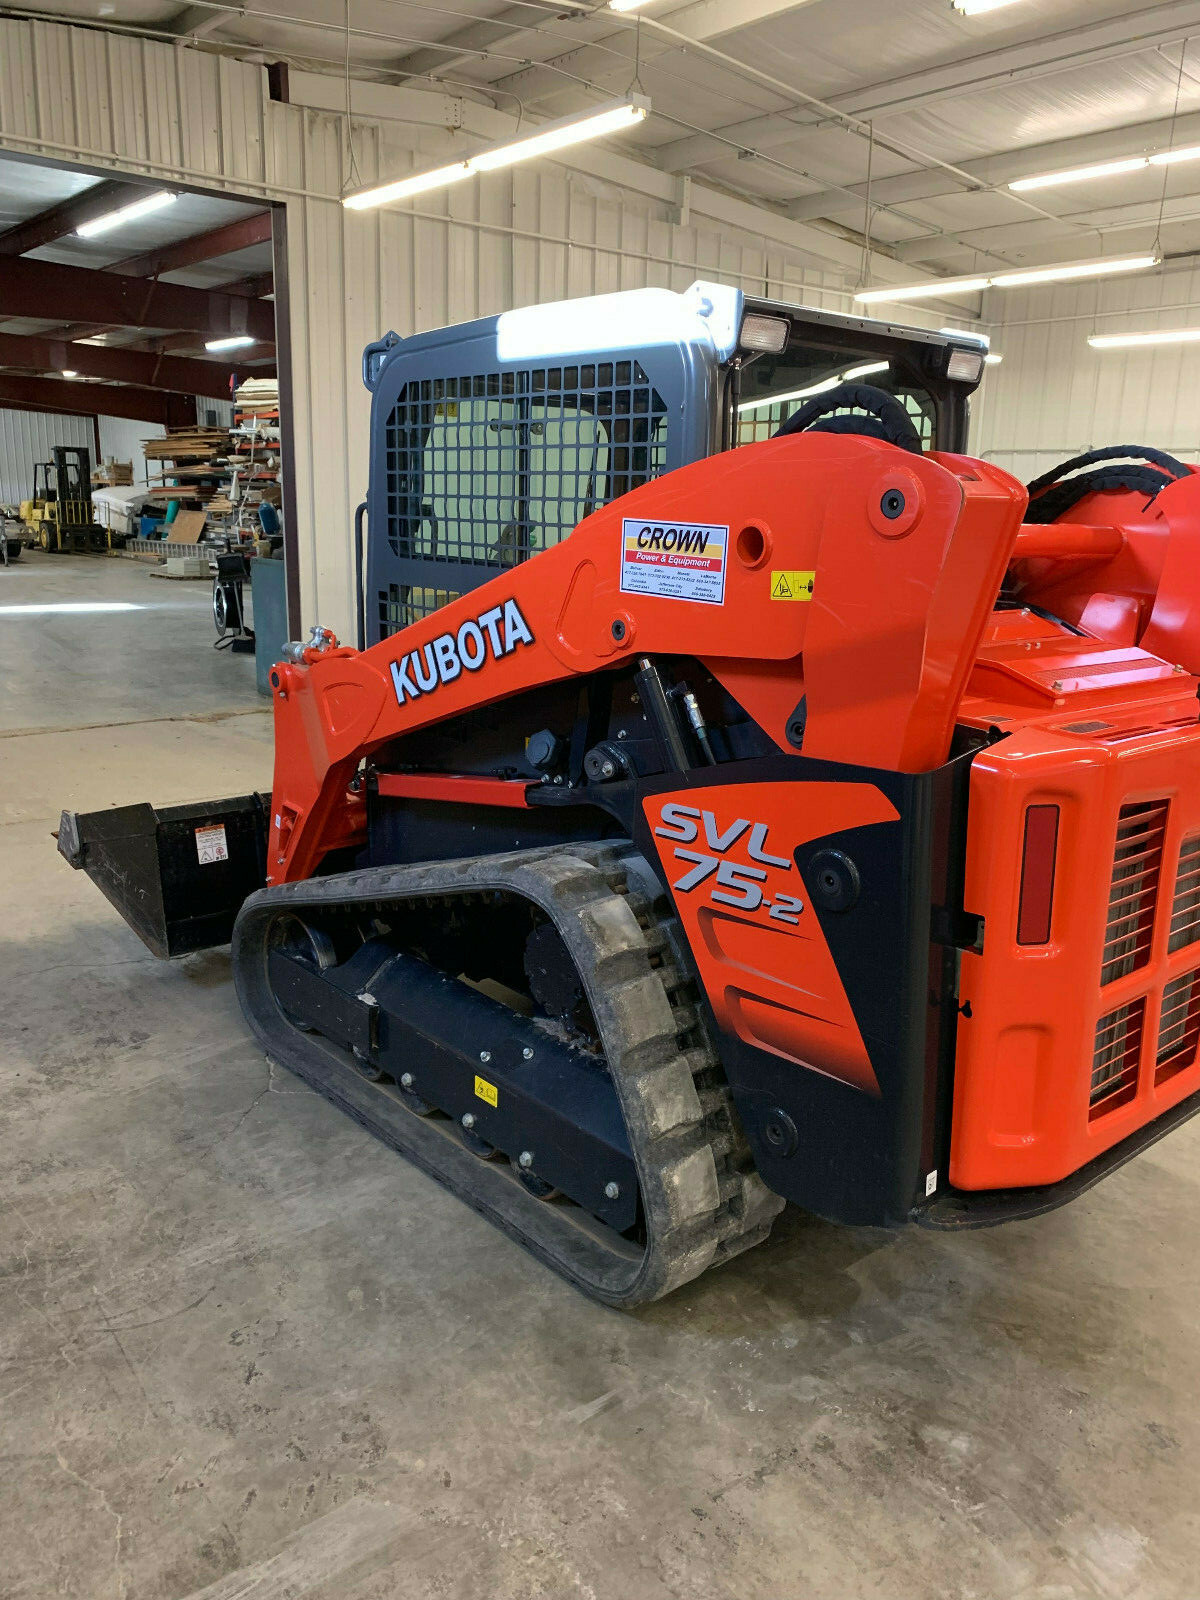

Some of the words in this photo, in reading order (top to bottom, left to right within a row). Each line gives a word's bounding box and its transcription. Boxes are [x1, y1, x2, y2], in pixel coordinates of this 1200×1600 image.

[636, 552, 659, 562] Power
[660, 554, 666, 563] &
[668, 555, 711, 568] Equipment
[637, 526, 710, 554] CROWN
[389, 598, 535, 705] KUBOTA
[655, 803, 792, 871] SVL
[673, 847, 804, 926] 75-2
